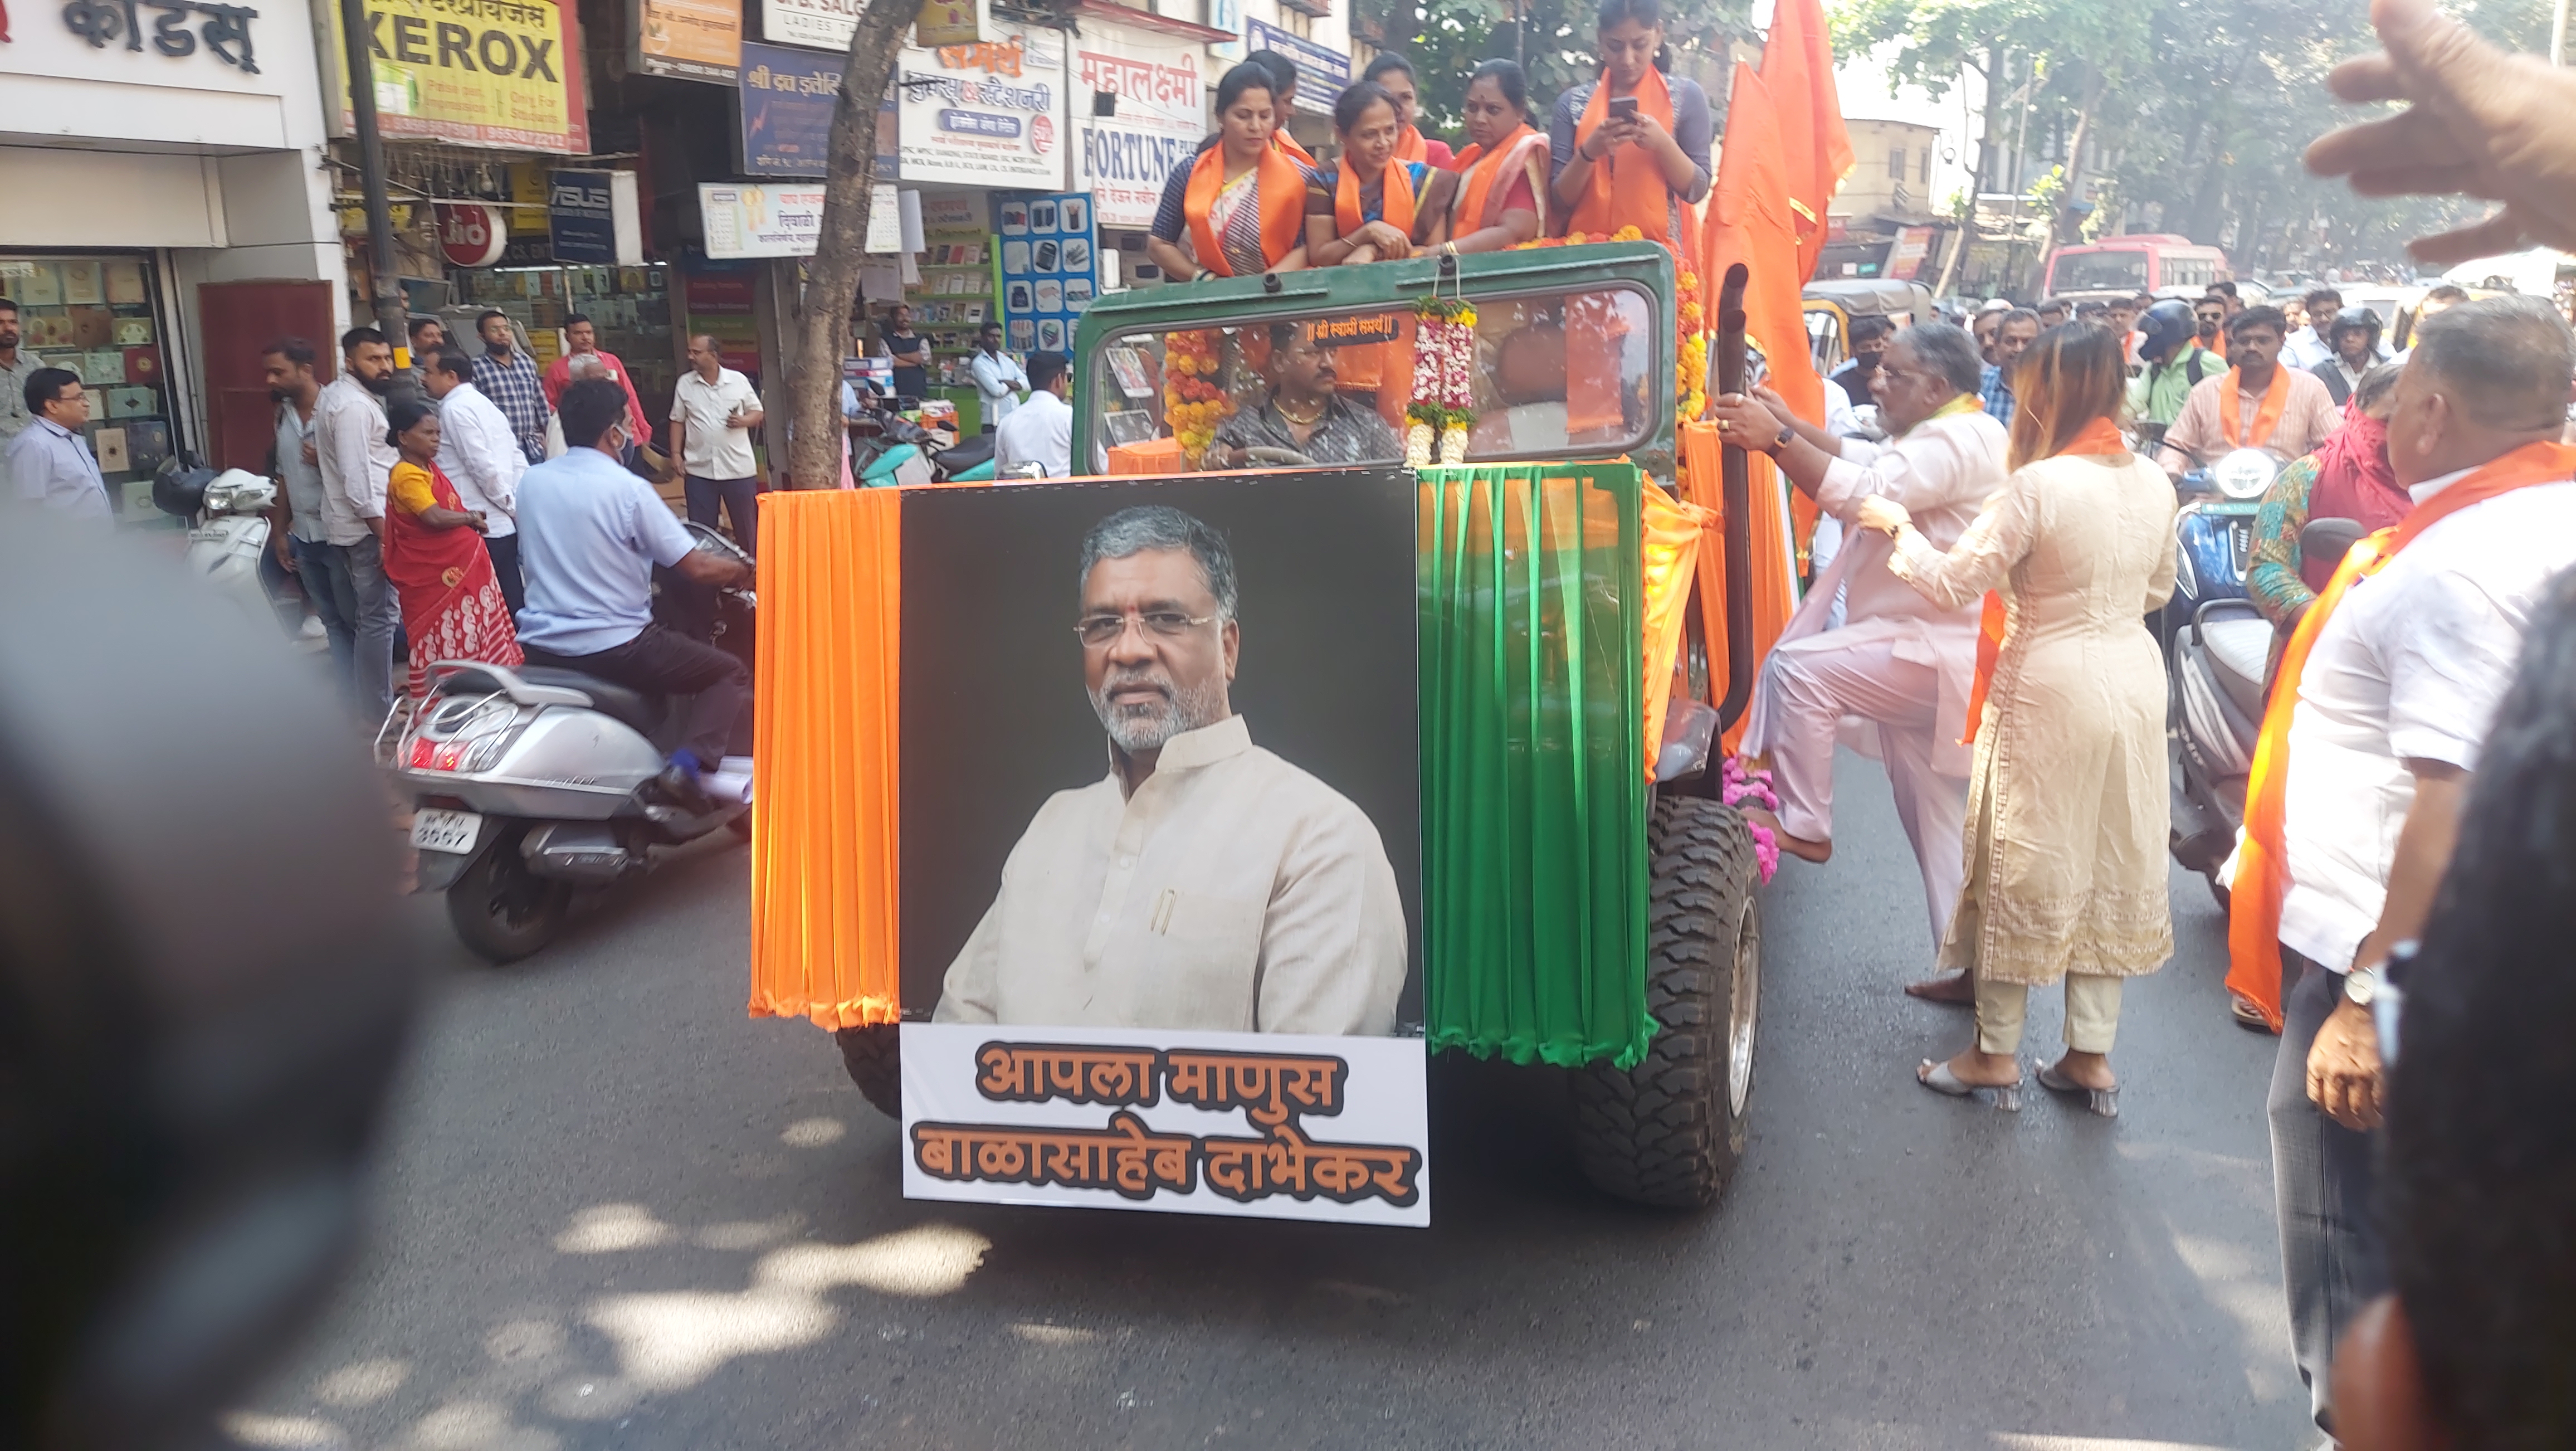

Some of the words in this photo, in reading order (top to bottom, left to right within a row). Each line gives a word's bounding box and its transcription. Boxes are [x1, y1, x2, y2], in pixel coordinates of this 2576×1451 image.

[747, 65, 772, 90] श्री
[1078, 50, 1197, 108] महालक्ष्मी
[551, 186, 611, 209] ASUS
[444, 214, 487, 246] Jio
[1316, 319, 1330, 340] श्री
[980, 1048, 1155, 1100] आपला
[1168, 1054, 1338, 1124] माणुस
[918, 1117, 1193, 1192] बाळासाहेब
[1204, 1122, 1412, 1197] दाभेकर
